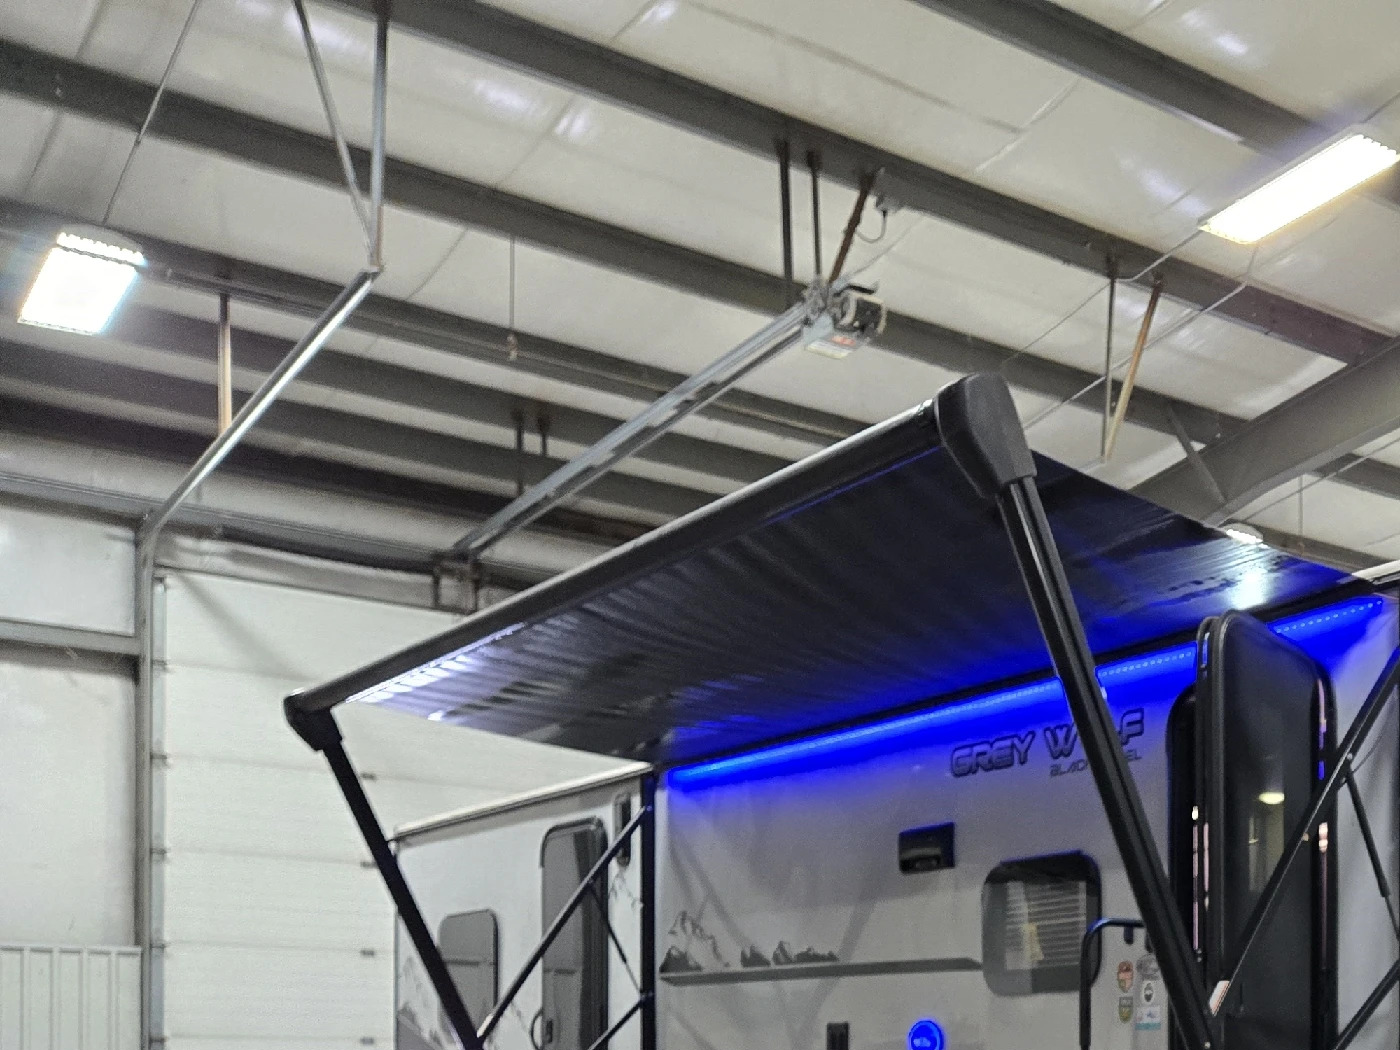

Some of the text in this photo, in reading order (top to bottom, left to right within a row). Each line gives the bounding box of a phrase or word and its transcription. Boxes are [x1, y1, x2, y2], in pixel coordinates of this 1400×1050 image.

[951, 707, 1145, 778] GREY WF
[1050, 758, 1090, 778] BLAC
